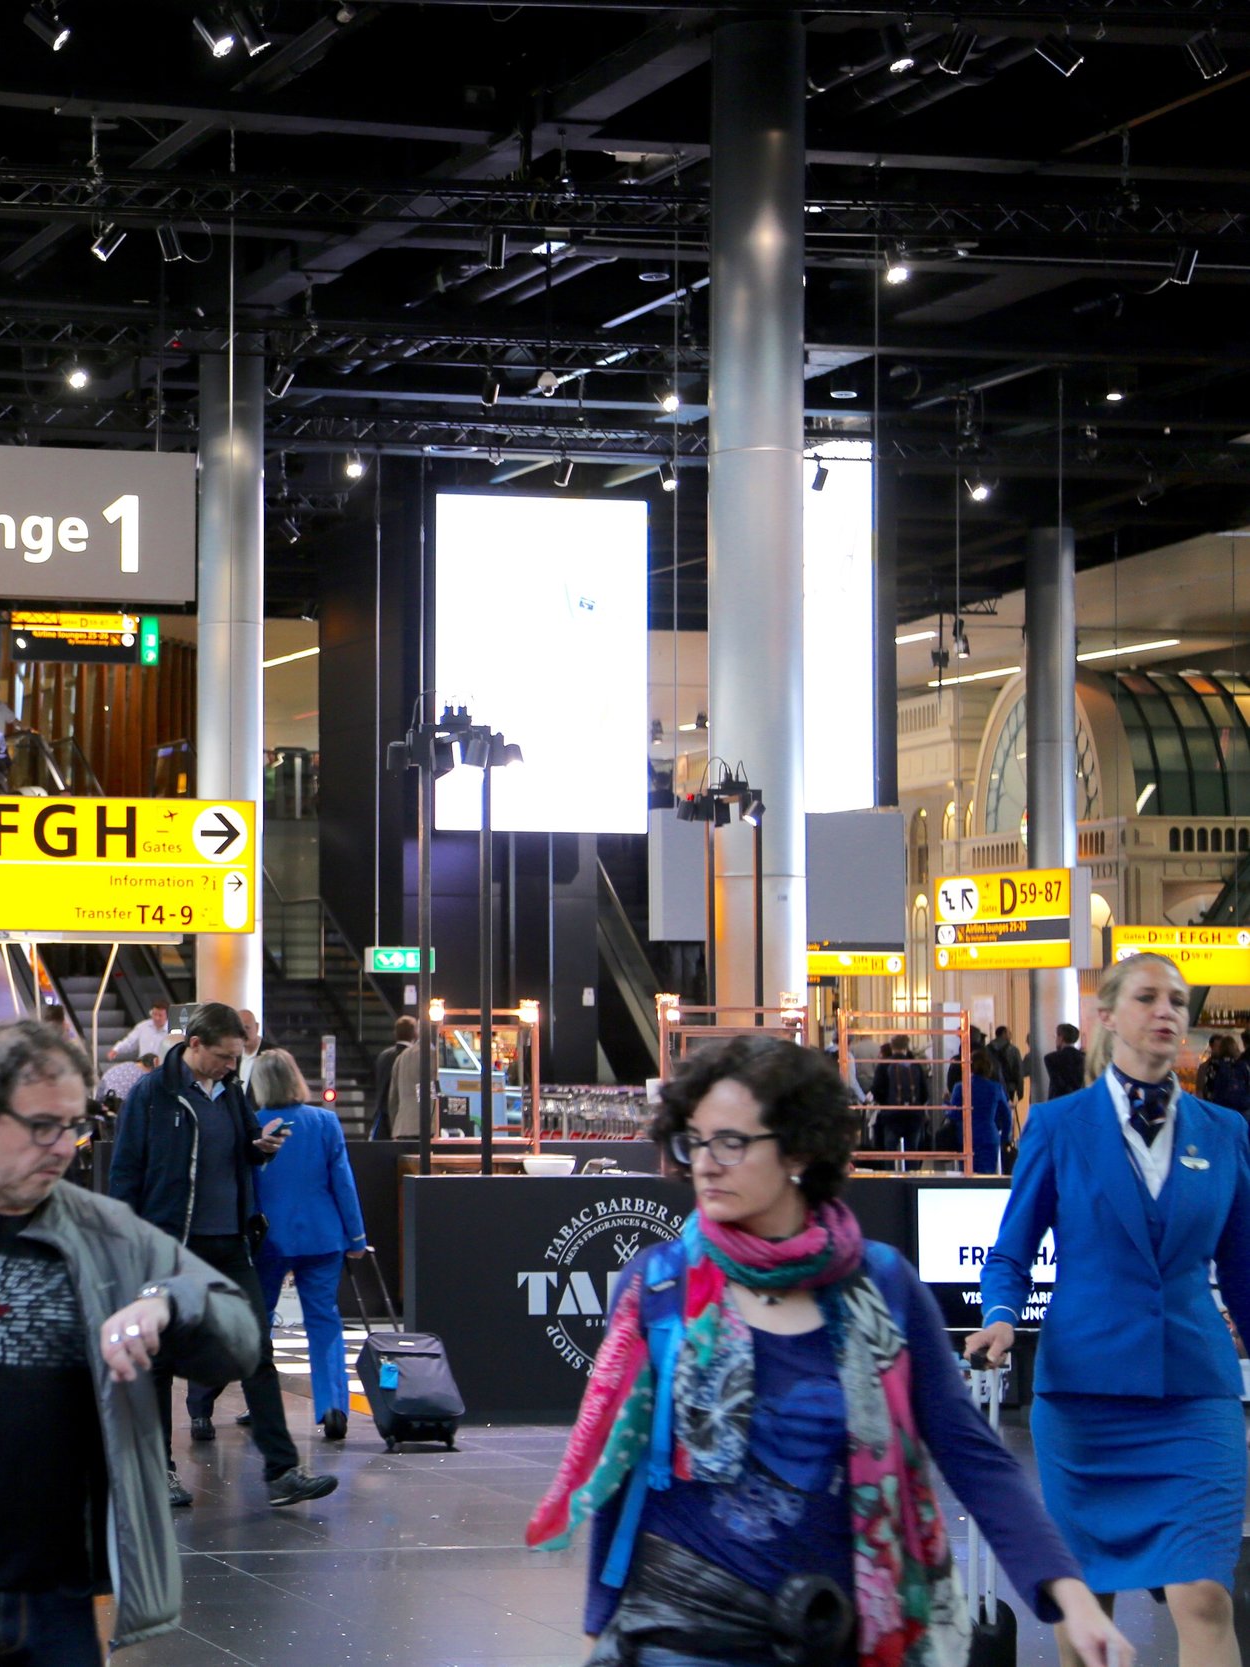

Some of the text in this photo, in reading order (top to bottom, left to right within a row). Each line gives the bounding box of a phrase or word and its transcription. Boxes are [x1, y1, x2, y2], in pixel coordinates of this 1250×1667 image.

[101, 494, 140, 574] 1
[142, 841, 183, 853] Gates
[109, 874, 195, 888] Information
[74, 904, 193, 925] Transfer T4-9
[544, 1207, 593, 1260] TABAC
[594, 1197, 668, 1221] BARBER
[563, 1217, 674, 1266] MEN'S FRAGRANCES & GROO
[961, 1291, 983, 1305] VIS
[546, 1325, 585, 1370] SHOP
